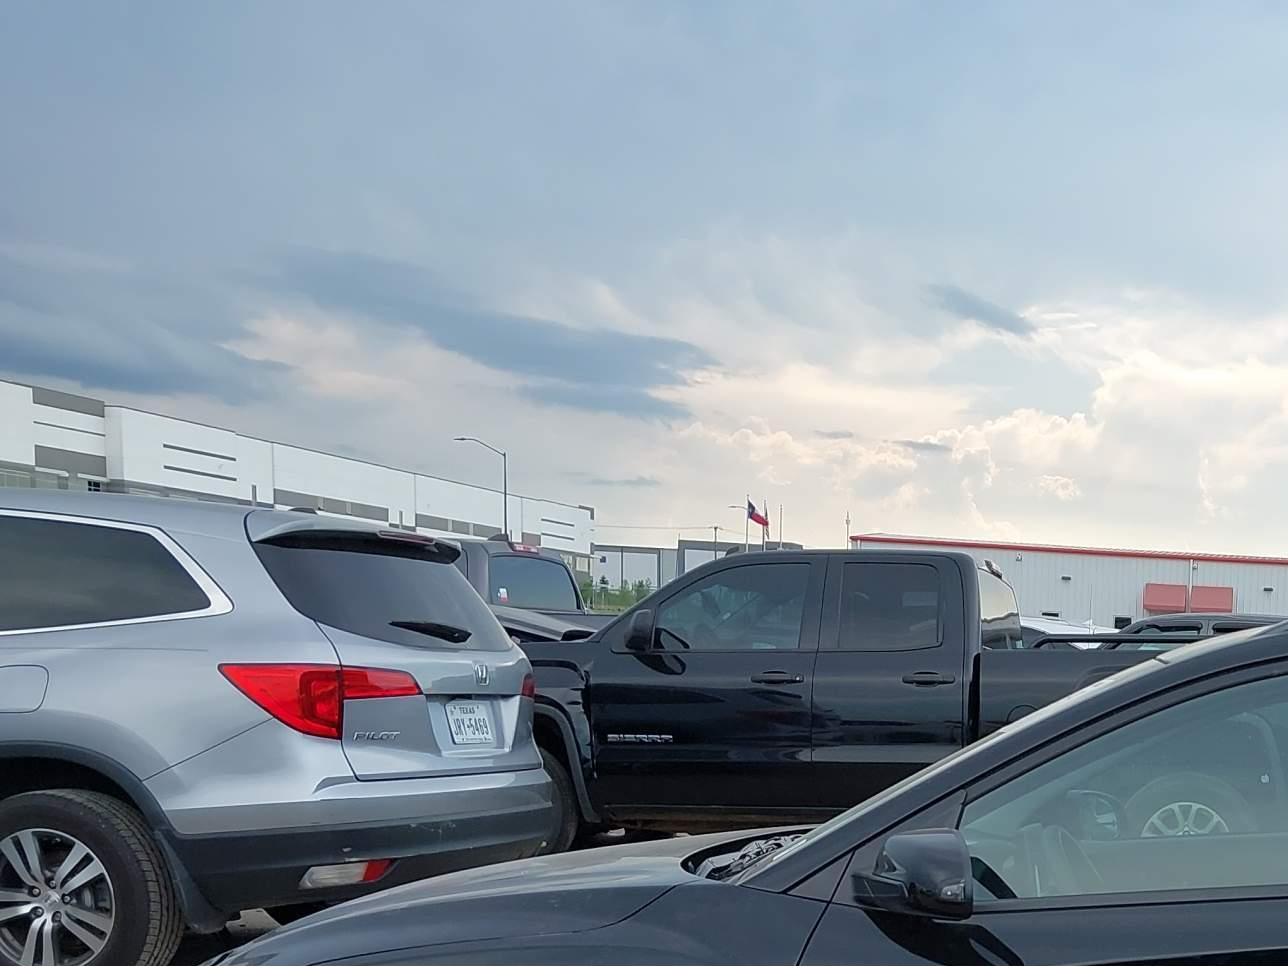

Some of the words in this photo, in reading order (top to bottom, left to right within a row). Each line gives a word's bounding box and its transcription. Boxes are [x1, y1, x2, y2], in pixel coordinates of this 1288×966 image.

[458, 706, 476, 714] TEXAS
[353, 731, 401, 741] PILOT
[607, 733, 673, 743] SIERRA
